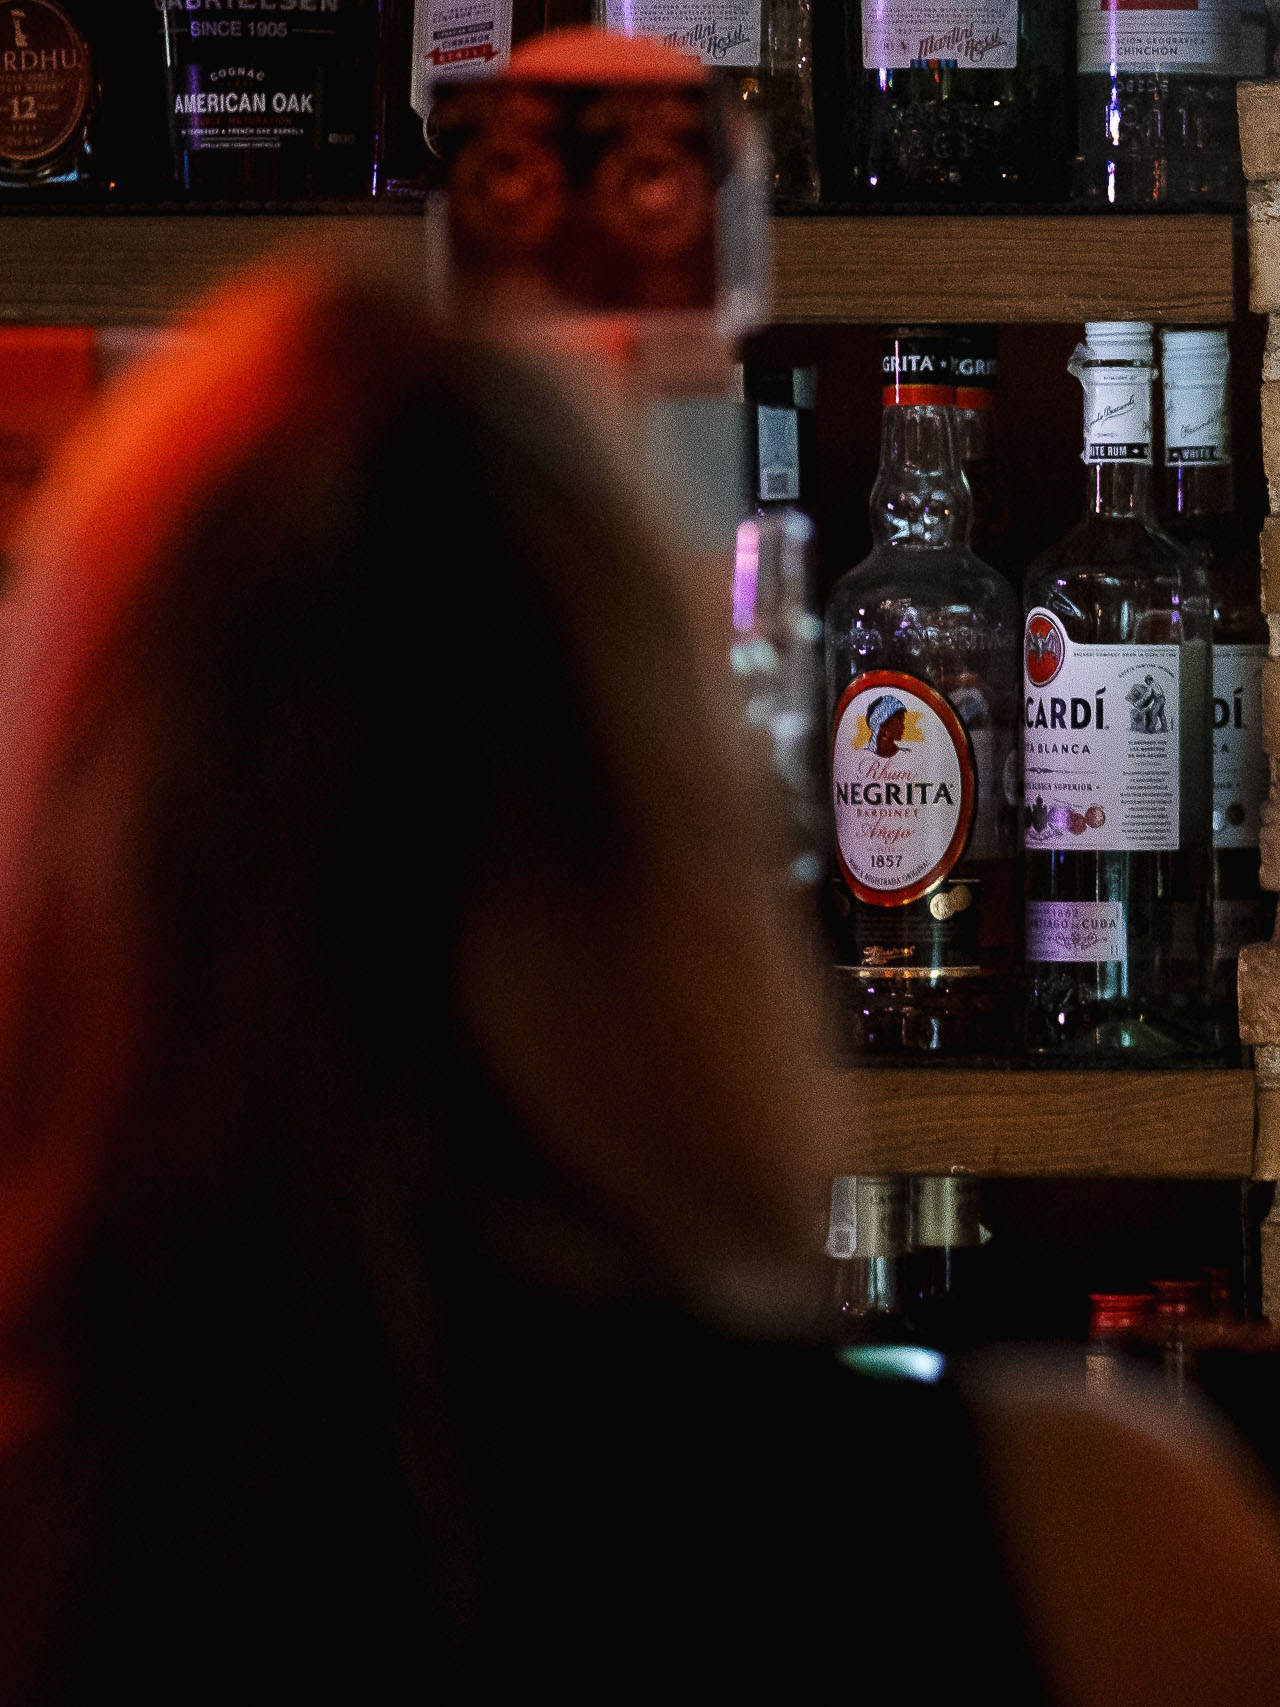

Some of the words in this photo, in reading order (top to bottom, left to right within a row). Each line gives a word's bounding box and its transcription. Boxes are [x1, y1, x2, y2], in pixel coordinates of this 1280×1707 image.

[190, 20, 242, 38] SINCE
[247, 20, 289, 38] 1905
[209, 66, 266, 83] COGNAC
[9, 95, 38, 120] 12
[174, 92, 267, 115] AMERICAN
[271, 92, 315, 115] OAK
[881, 354, 935, 373] GRITA
[1107, 446, 1128, 457] RUM
[1026, 686, 1107, 730] CARDÍ
[1037, 743, 1092, 755] BLANCA
[836, 782, 954, 806] NEGRITA
[856, 808, 919, 818] BARDINET
[869, 855, 903, 869] 1857
[1081, 918, 1118, 931] CUBA
